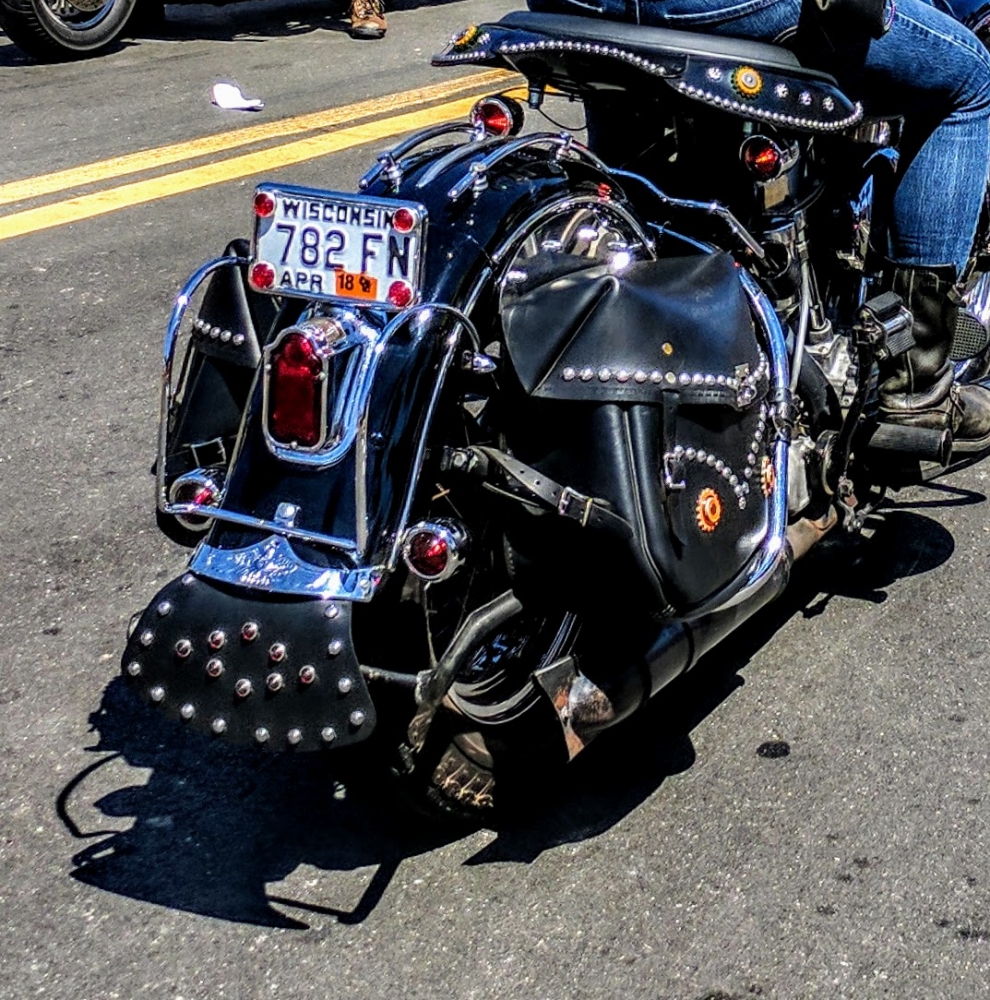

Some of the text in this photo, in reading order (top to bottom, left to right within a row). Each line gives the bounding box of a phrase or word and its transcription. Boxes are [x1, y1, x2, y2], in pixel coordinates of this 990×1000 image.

[282, 199, 396, 231] WISCONSIN
[276, 223, 411, 277] 782 FN
[280, 271, 354, 293] APR 18
